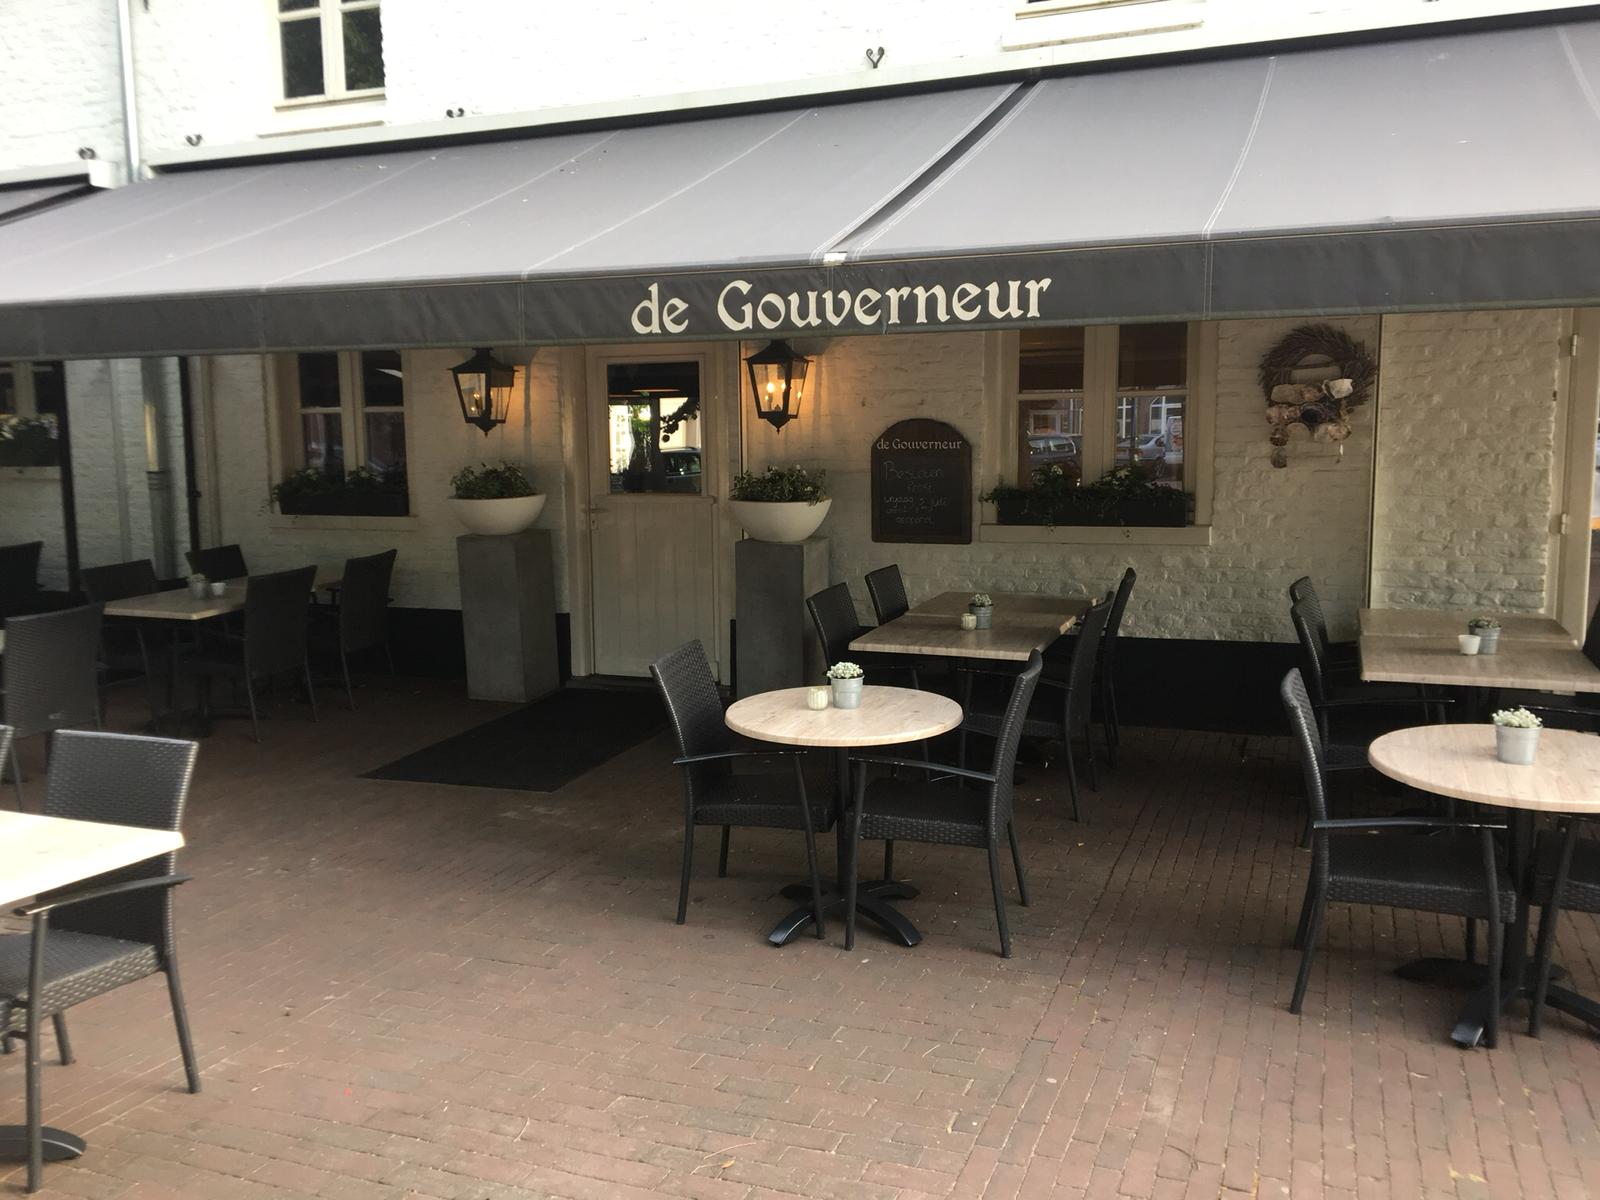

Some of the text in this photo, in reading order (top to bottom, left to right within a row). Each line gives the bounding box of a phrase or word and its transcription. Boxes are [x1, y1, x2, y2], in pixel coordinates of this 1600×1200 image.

[630, 277, 1052, 335] de Gouverneur
[876, 438, 963, 450] de Gouverneur
